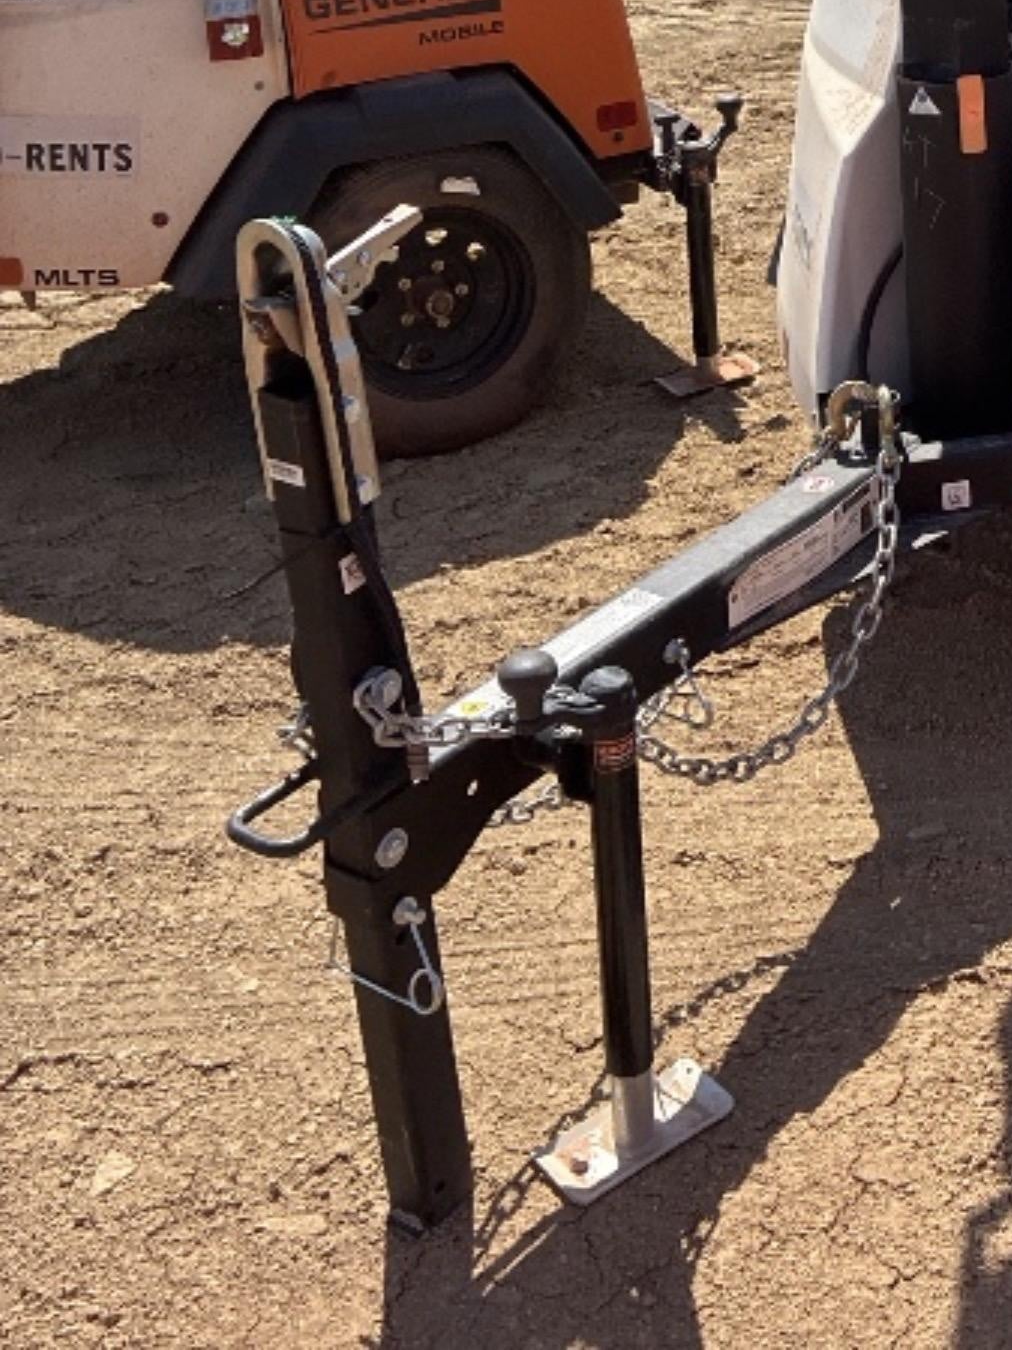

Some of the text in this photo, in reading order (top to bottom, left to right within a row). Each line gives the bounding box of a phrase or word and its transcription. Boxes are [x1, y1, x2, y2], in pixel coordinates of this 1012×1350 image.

[419, 21, 503, 45] MOBILE
[0, 143, 132, 172] -RENTS
[34, 269, 120, 286] MLTS
